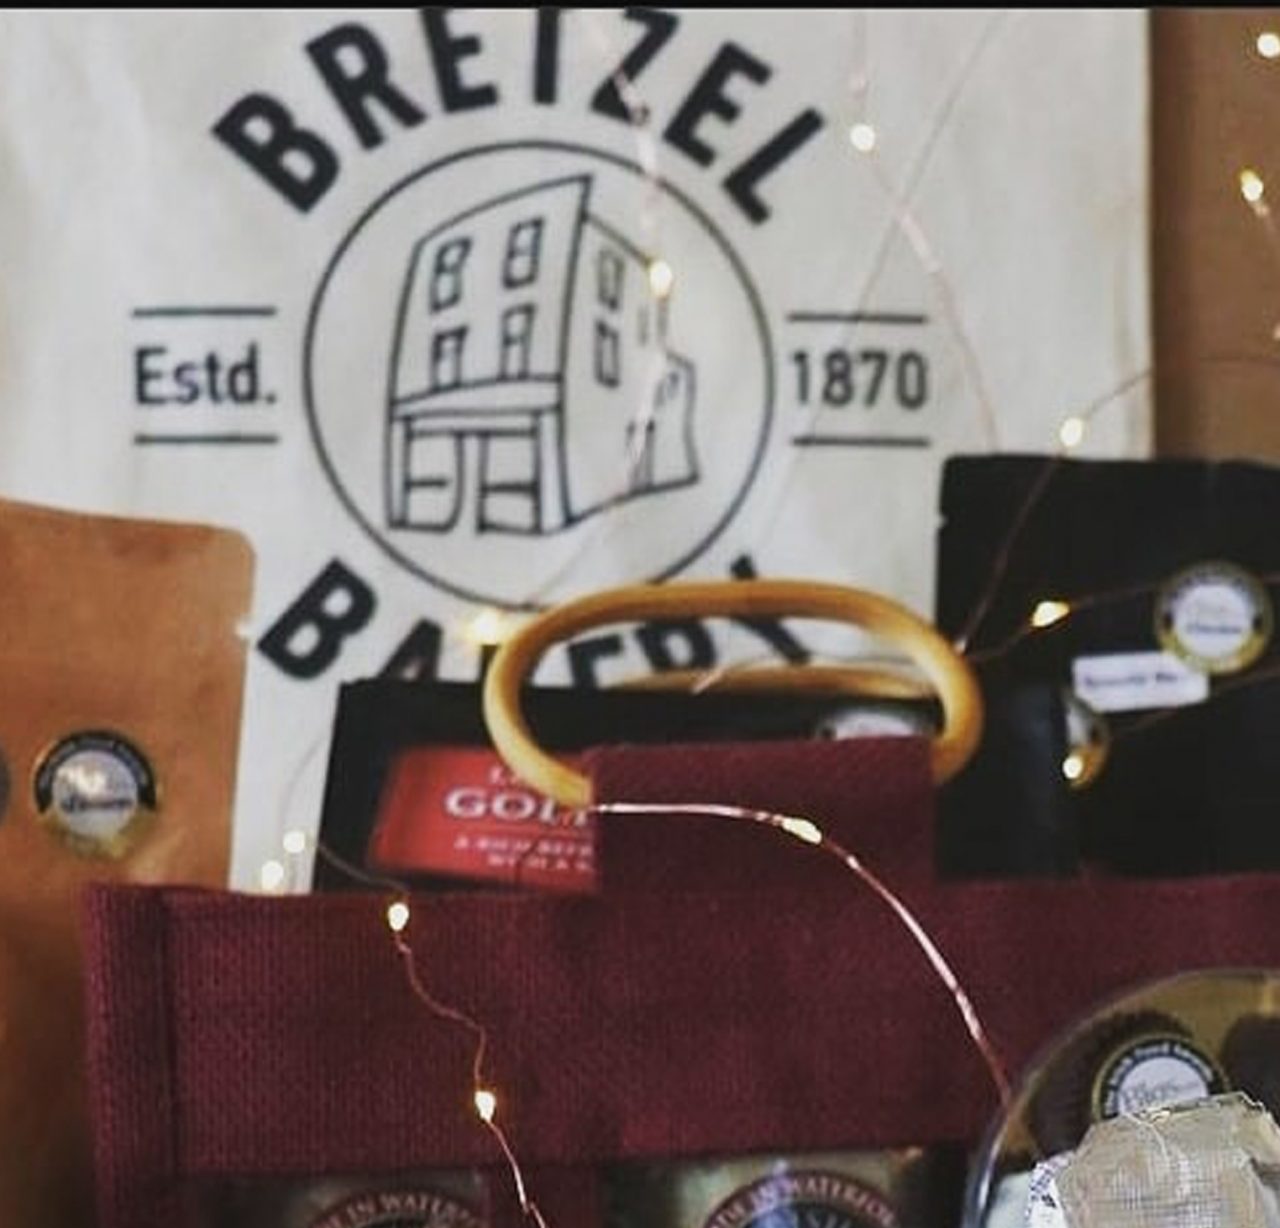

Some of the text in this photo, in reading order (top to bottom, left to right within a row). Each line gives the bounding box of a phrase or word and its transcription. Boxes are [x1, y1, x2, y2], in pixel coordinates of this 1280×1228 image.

[212, 8, 825, 225] BRETZEL
[133, 343, 278, 406] Estd.
[790, 349, 929, 410] 1870
[257, 556, 812, 690] BAER
